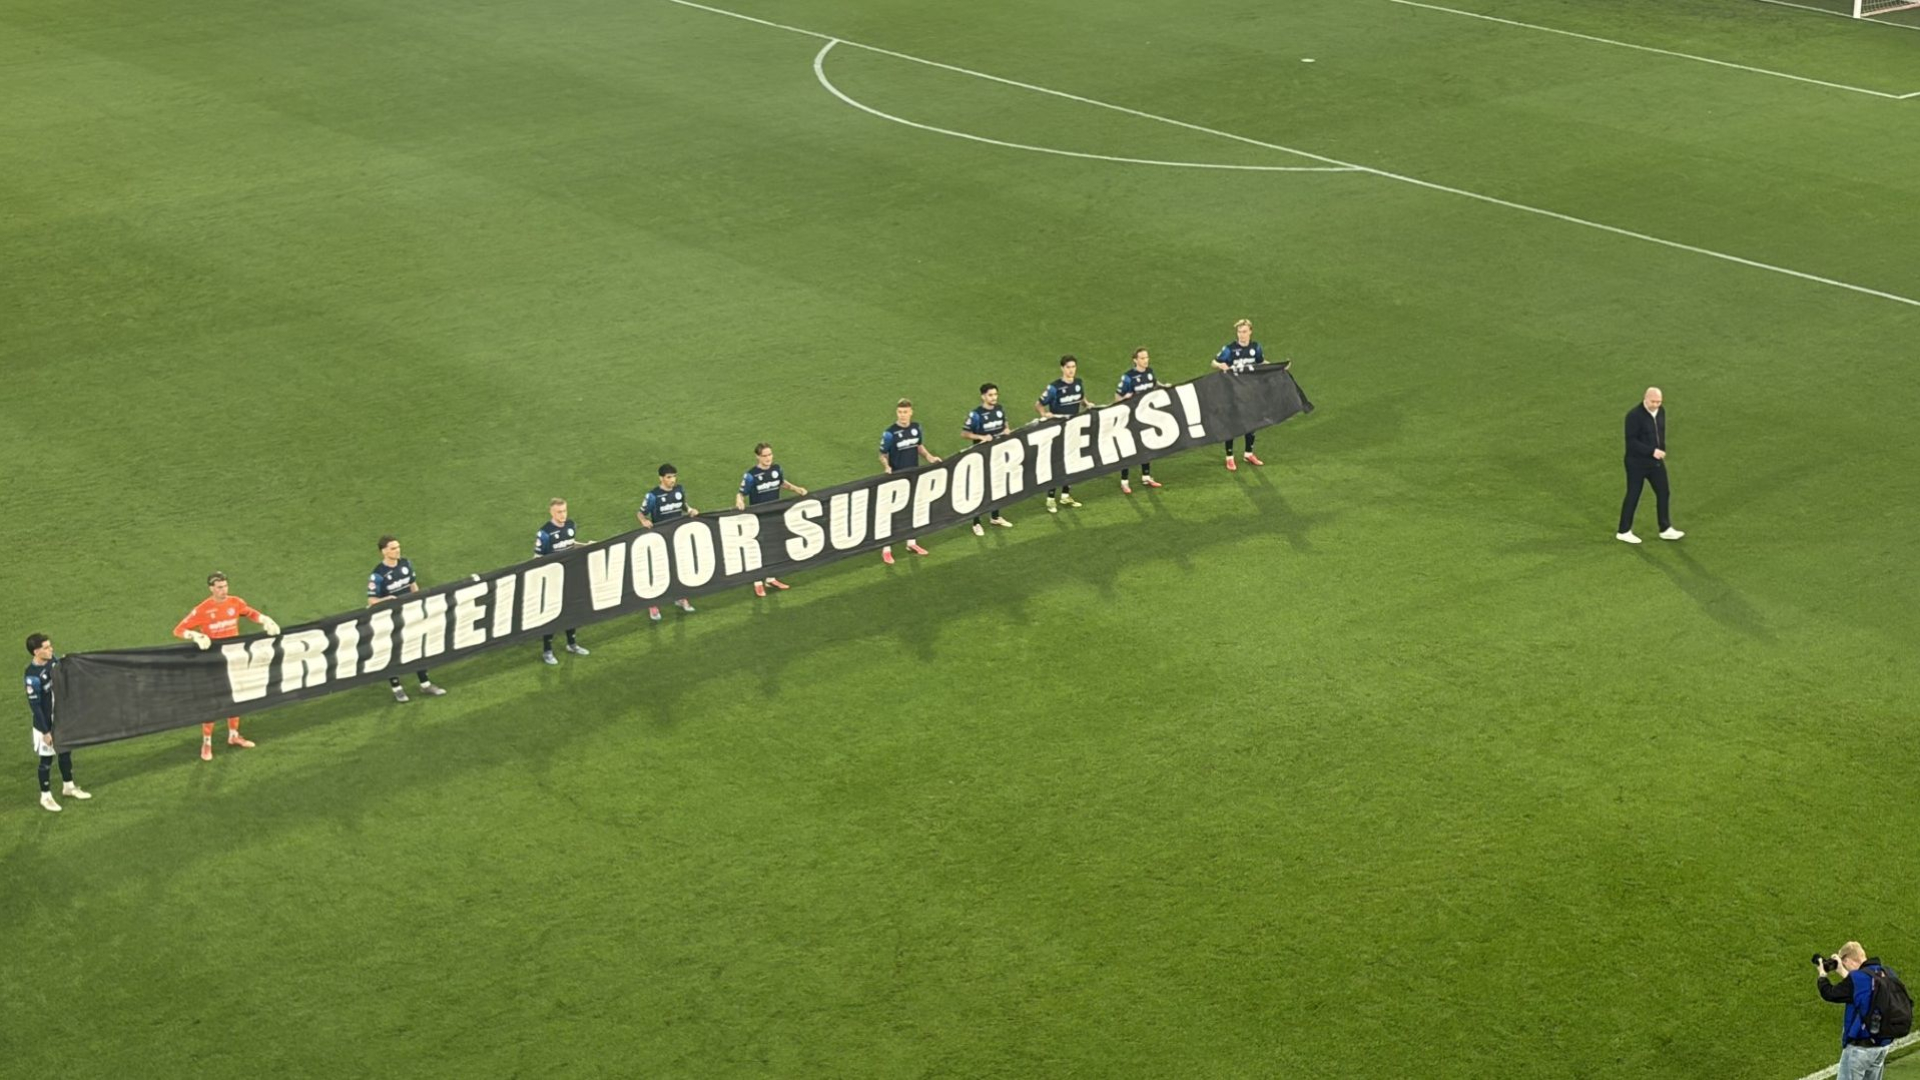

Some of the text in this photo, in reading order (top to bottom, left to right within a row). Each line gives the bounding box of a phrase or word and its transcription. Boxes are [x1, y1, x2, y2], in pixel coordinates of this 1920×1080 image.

[222, 383, 1206, 703] VRIJHEID VOOR SUPPORTERS!
